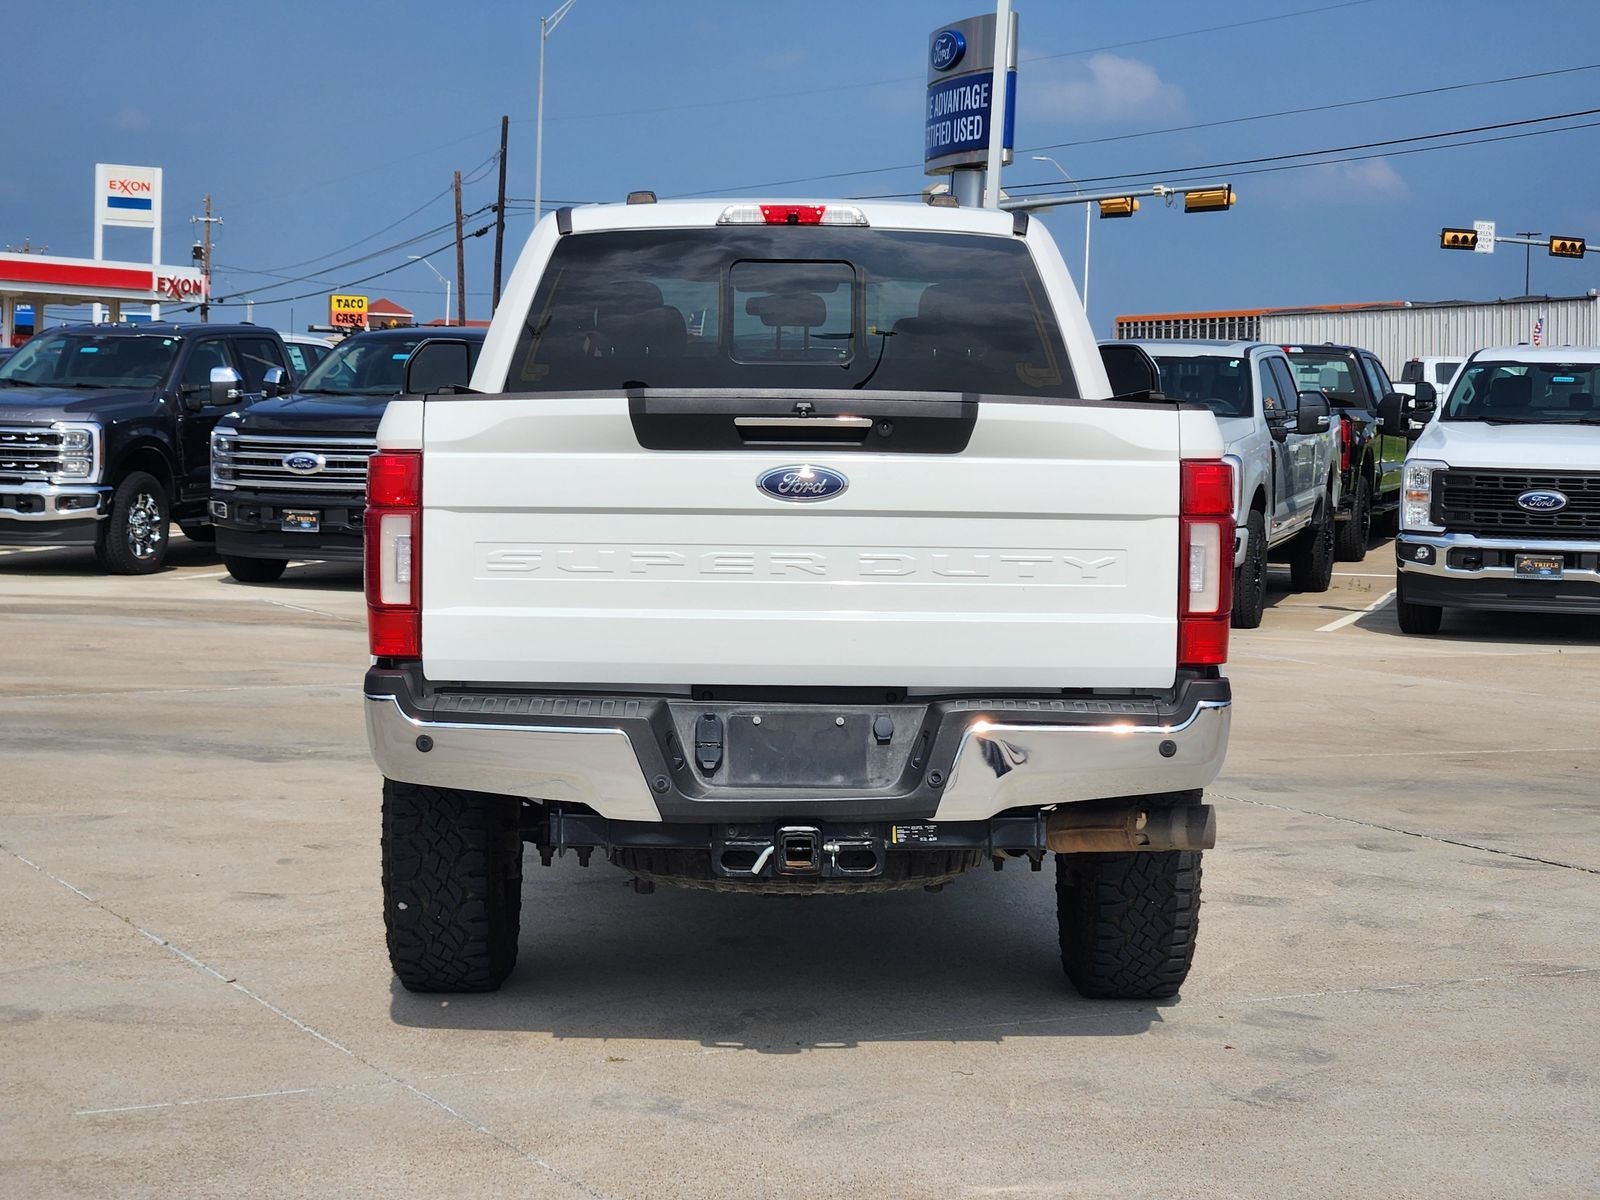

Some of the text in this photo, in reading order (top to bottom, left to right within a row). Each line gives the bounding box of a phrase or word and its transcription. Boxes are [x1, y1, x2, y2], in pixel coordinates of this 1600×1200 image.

[934, 39, 952, 63] Ford
[934, 83, 989, 118] ADVANTAGE
[953, 115, 983, 143] USED
[109, 179, 151, 195] EXXON
[157, 276, 202, 300] EXXON
[336, 298, 364, 309] TACO
[336, 313, 363, 324] CASA
[777, 471, 828, 496] Ford
[1529, 495, 1555, 507] Ford
[485, 548, 1119, 579] SUPER DUTY
[1534, 561, 1559, 569] TRIPLE
